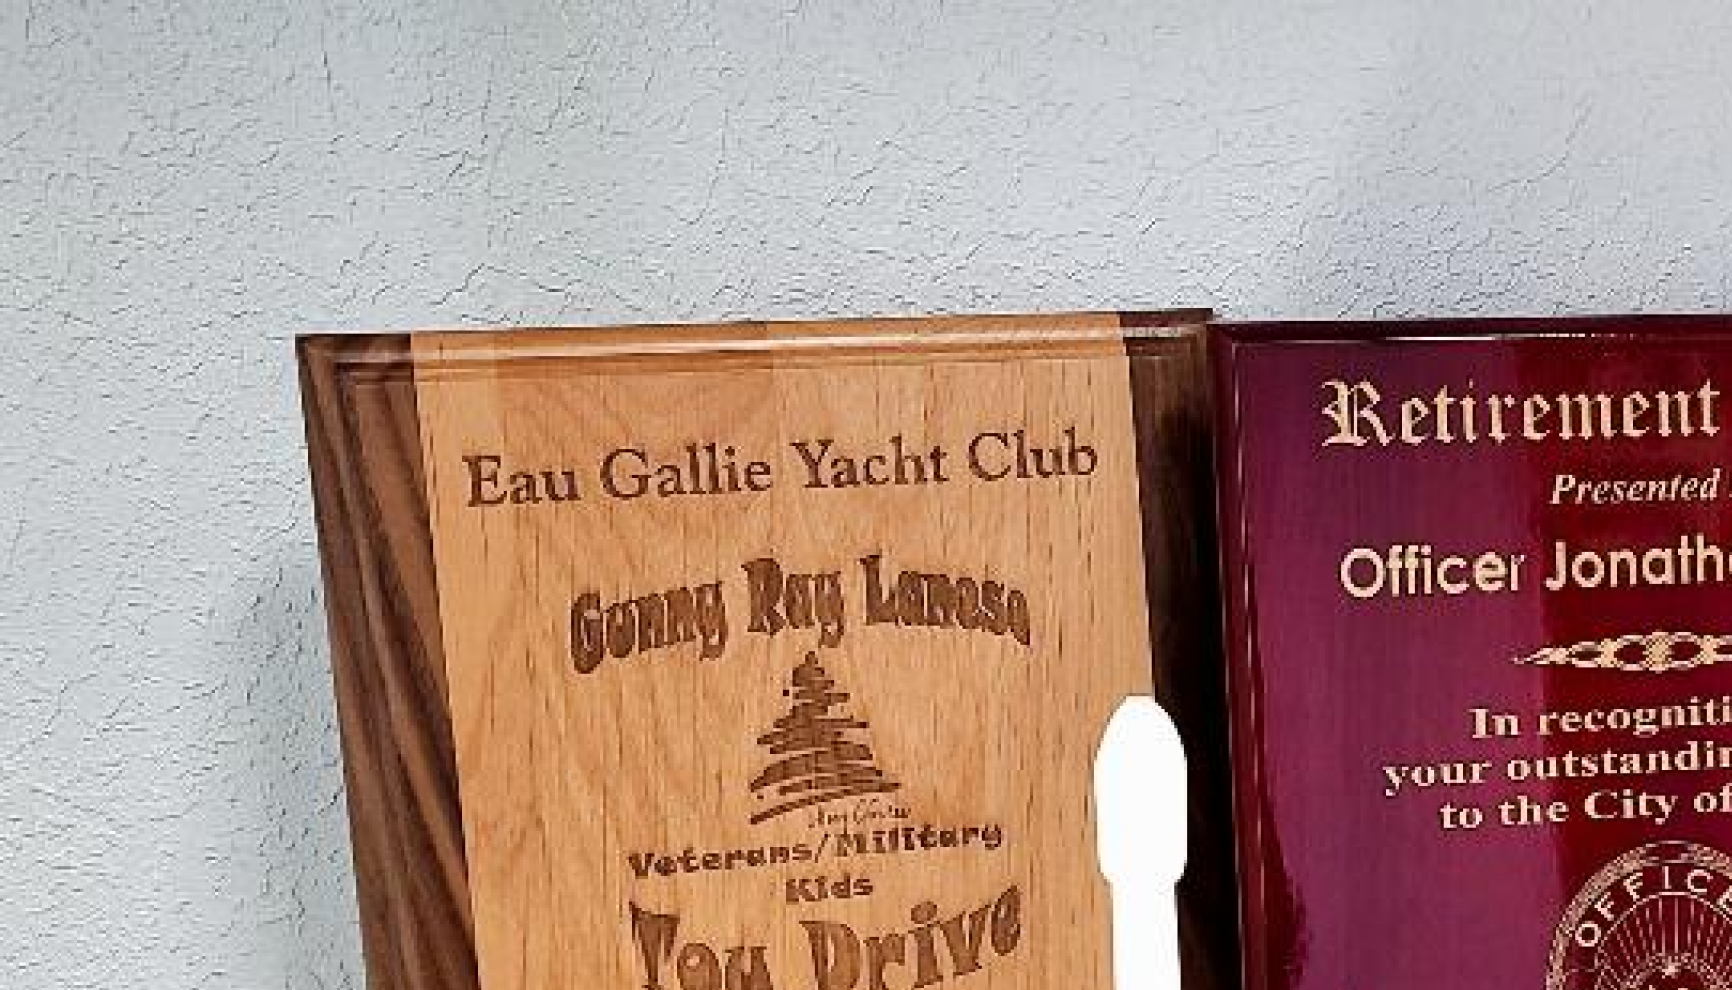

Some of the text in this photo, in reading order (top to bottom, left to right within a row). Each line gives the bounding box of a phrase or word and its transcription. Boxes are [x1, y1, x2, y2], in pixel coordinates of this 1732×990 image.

[1321, 377, 1721, 447] Retirement
[461, 426, 1099, 508] Eau Gallie Yacht Club
[1550, 467, 1722, 505] Presented
[1340, 544, 1527, 599] Officer
[571, 580, 729, 675] Gunny
[740, 556, 845, 649] Ray
[1468, 707, 1520, 740] In
[1383, 761, 1494, 797] your
[1440, 801, 1484, 829] to
[1498, 794, 1571, 826] the
[1583, 788, 1680, 826] City
[628, 822, 1004, 879] Veterans/Military
[785, 872, 875, 904] Kids
